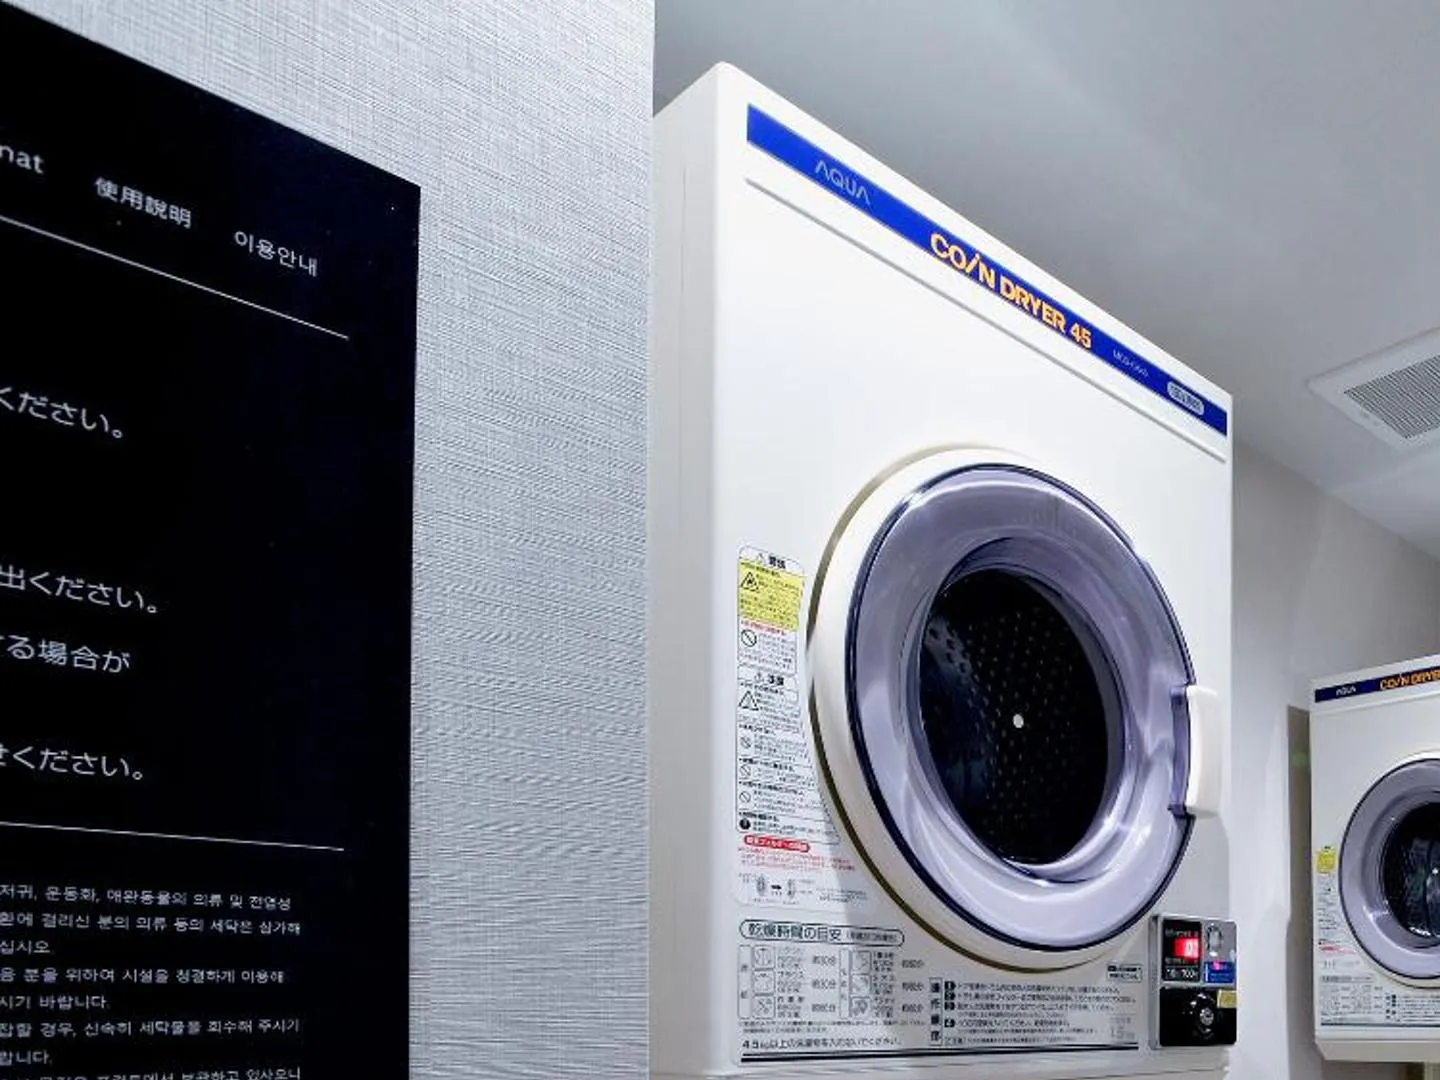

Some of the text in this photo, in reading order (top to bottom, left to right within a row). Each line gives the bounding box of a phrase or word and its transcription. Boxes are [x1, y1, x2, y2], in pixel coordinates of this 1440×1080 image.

[234, 230, 318, 277] 이용안내
[816, 160, 1092, 349] AQUA COIN DRYER 45
[0, 634, 130, 673] る場合が
[193, 894, 222, 907] 의류
[136, 916, 167, 932] 의류
[65, 968, 115, 983] 위하여
[122, 968, 169, 984] 시설을
[176, 969, 235, 984] 청결하게
[84, 1021, 132, 1037] 신속히
[140, 1020, 201, 1035] 세탁물을
[207, 1019, 253, 1034] 회수해
[258, 1018, 300, 1033] 주시기
